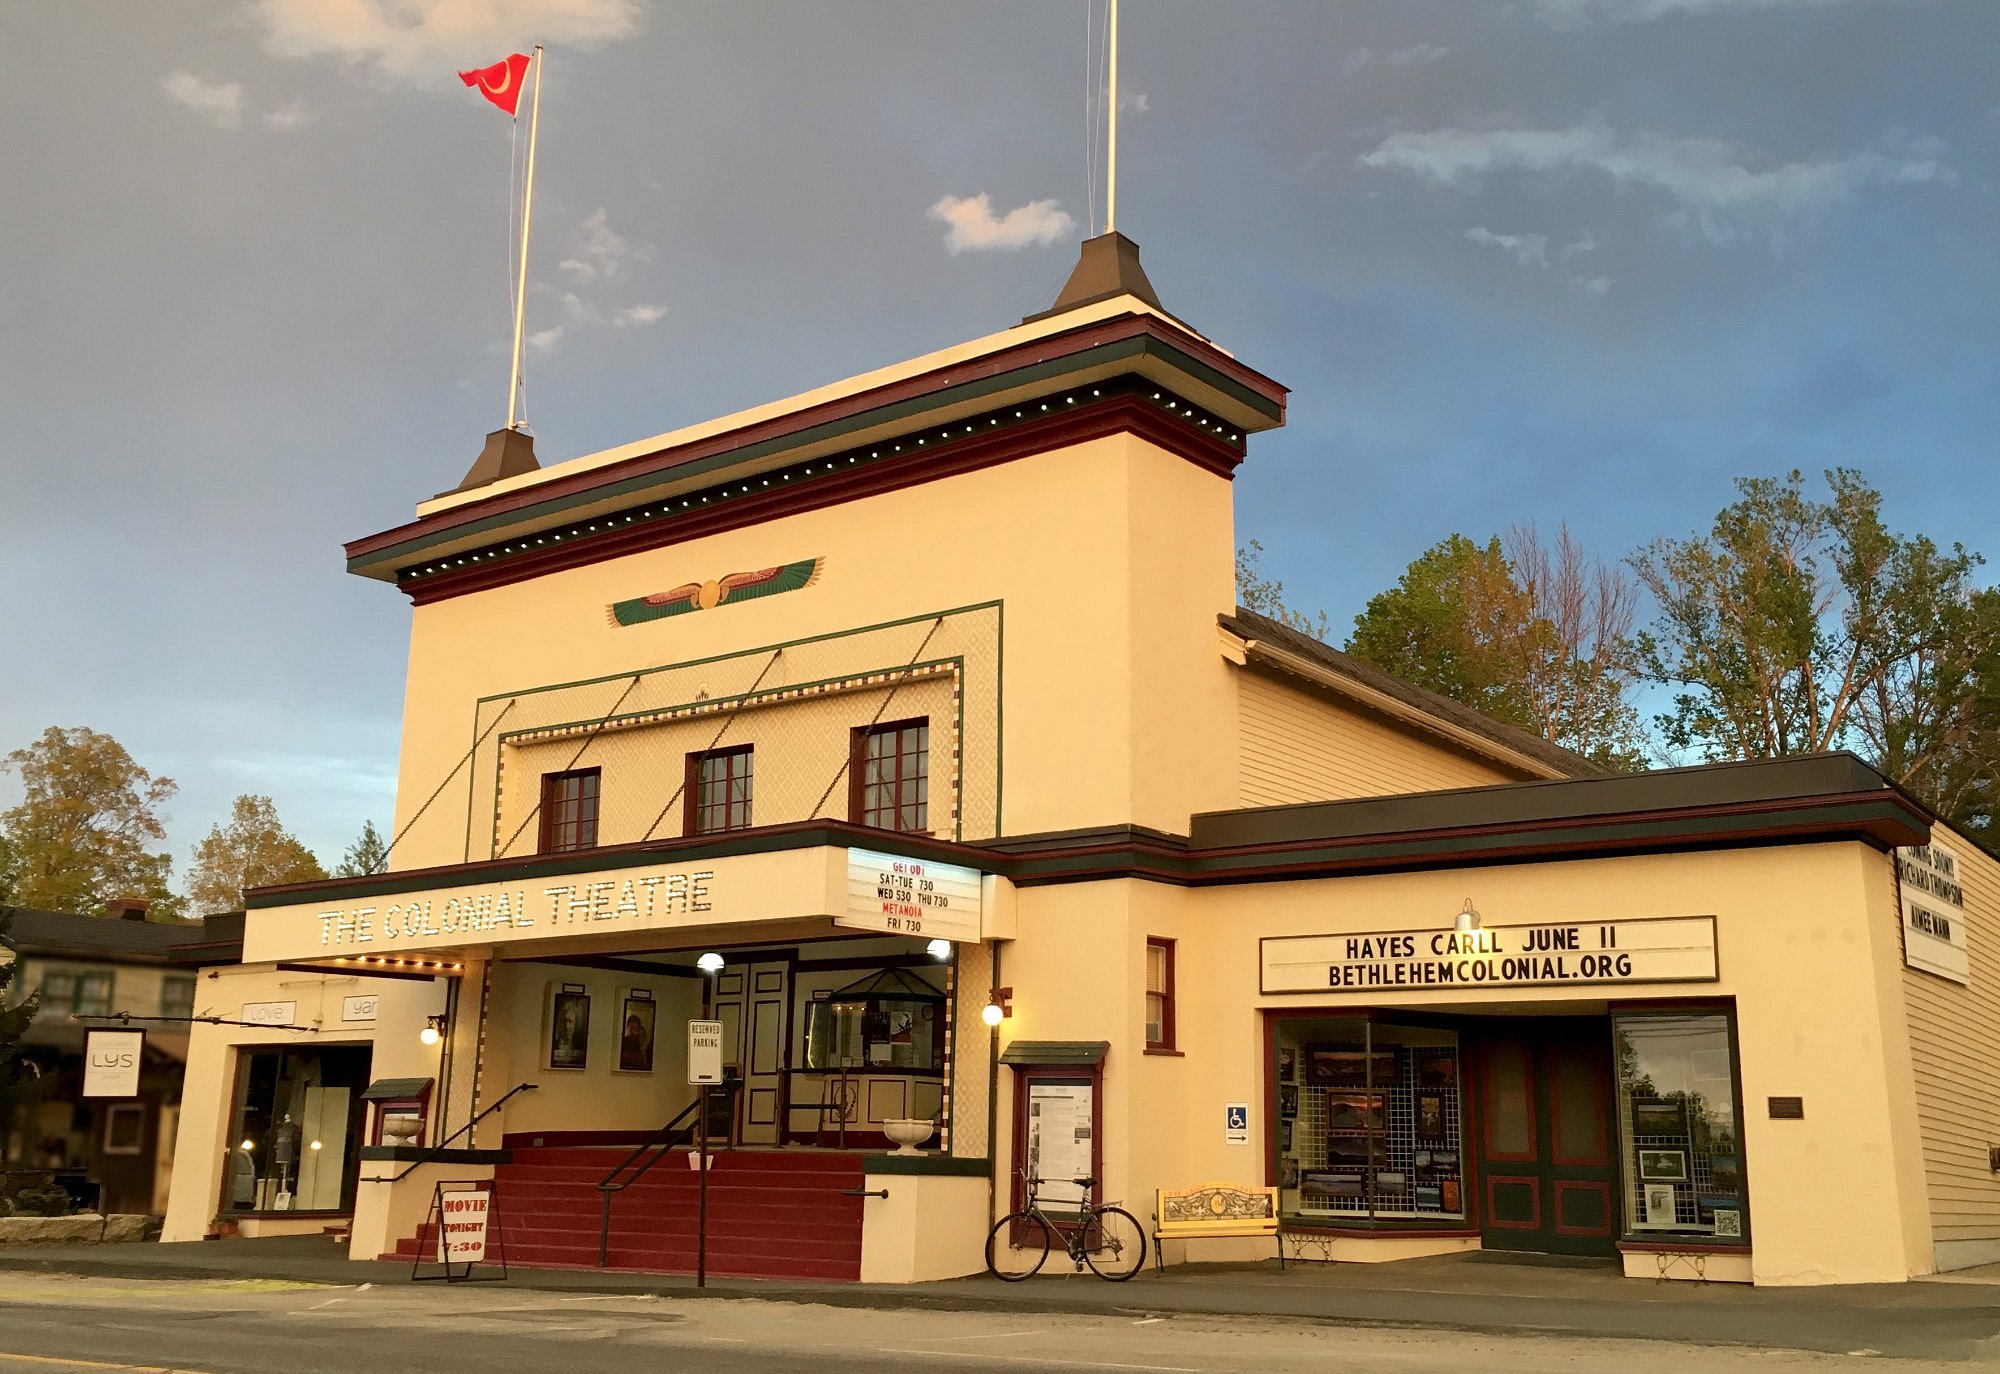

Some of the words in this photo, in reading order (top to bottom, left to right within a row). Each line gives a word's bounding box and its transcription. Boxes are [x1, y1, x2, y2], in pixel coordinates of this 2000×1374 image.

[880, 873, 913, 889] SAT-TUE
[919, 880, 934, 891] 730
[1898, 857, 1930, 892] RICHARD
[1929, 872, 1964, 909] THOMPSON
[877, 887, 893, 899] WED
[896, 891, 911, 902] 530
[917, 893, 932, 905] THU
[934, 896, 948, 907] 730
[318, 907, 377, 944] THE
[383, 891, 535, 938] COLONIAL
[543, 871, 714, 924] THEATRE
[882, 902, 923, 918] METANOIA
[887, 917, 901, 929] FRI
[906, 920, 921, 932] 730
[1911, 904, 1932, 934] AIMEE
[1932, 914, 1950, 940] MANN
[1346, 936, 1415, 960] HAYES
[1430, 932, 1503, 956] CARLL
[1522, 928, 1580, 952] JUNE
[1329, 953, 1632, 986] BETHLEHEMCOLONIAL.ORG
[692, 1024, 720, 1034] RESERVED
[694, 1038, 718, 1047] PARKING
[444, 1200, 487, 1212] MOVIE
[443, 1222, 483, 1232] TONIGHT
[442, 1242, 482, 1251] 7:30
